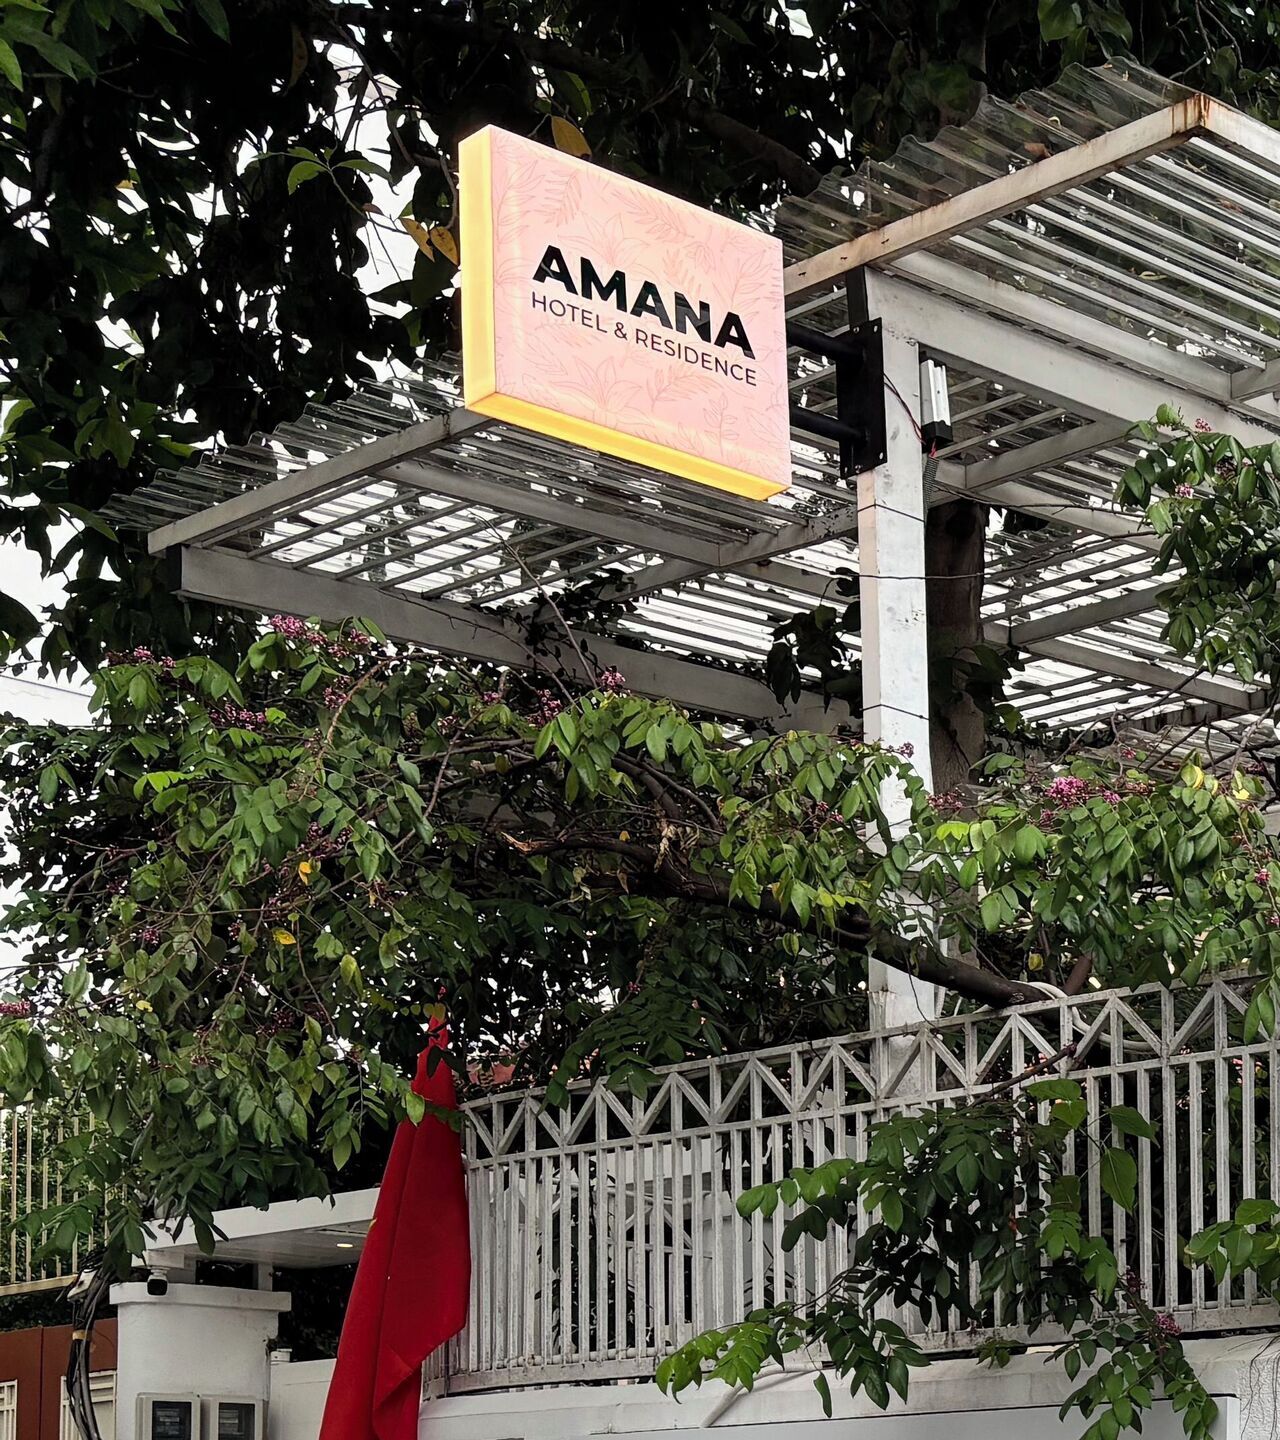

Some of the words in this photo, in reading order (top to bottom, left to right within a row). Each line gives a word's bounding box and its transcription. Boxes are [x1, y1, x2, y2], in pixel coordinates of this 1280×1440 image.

[531, 291, 608, 334] HOTEL
[613, 321, 628, 340] &
[635, 328, 758, 387] RESIDENCE
[532, 244, 756, 360] AMANA
